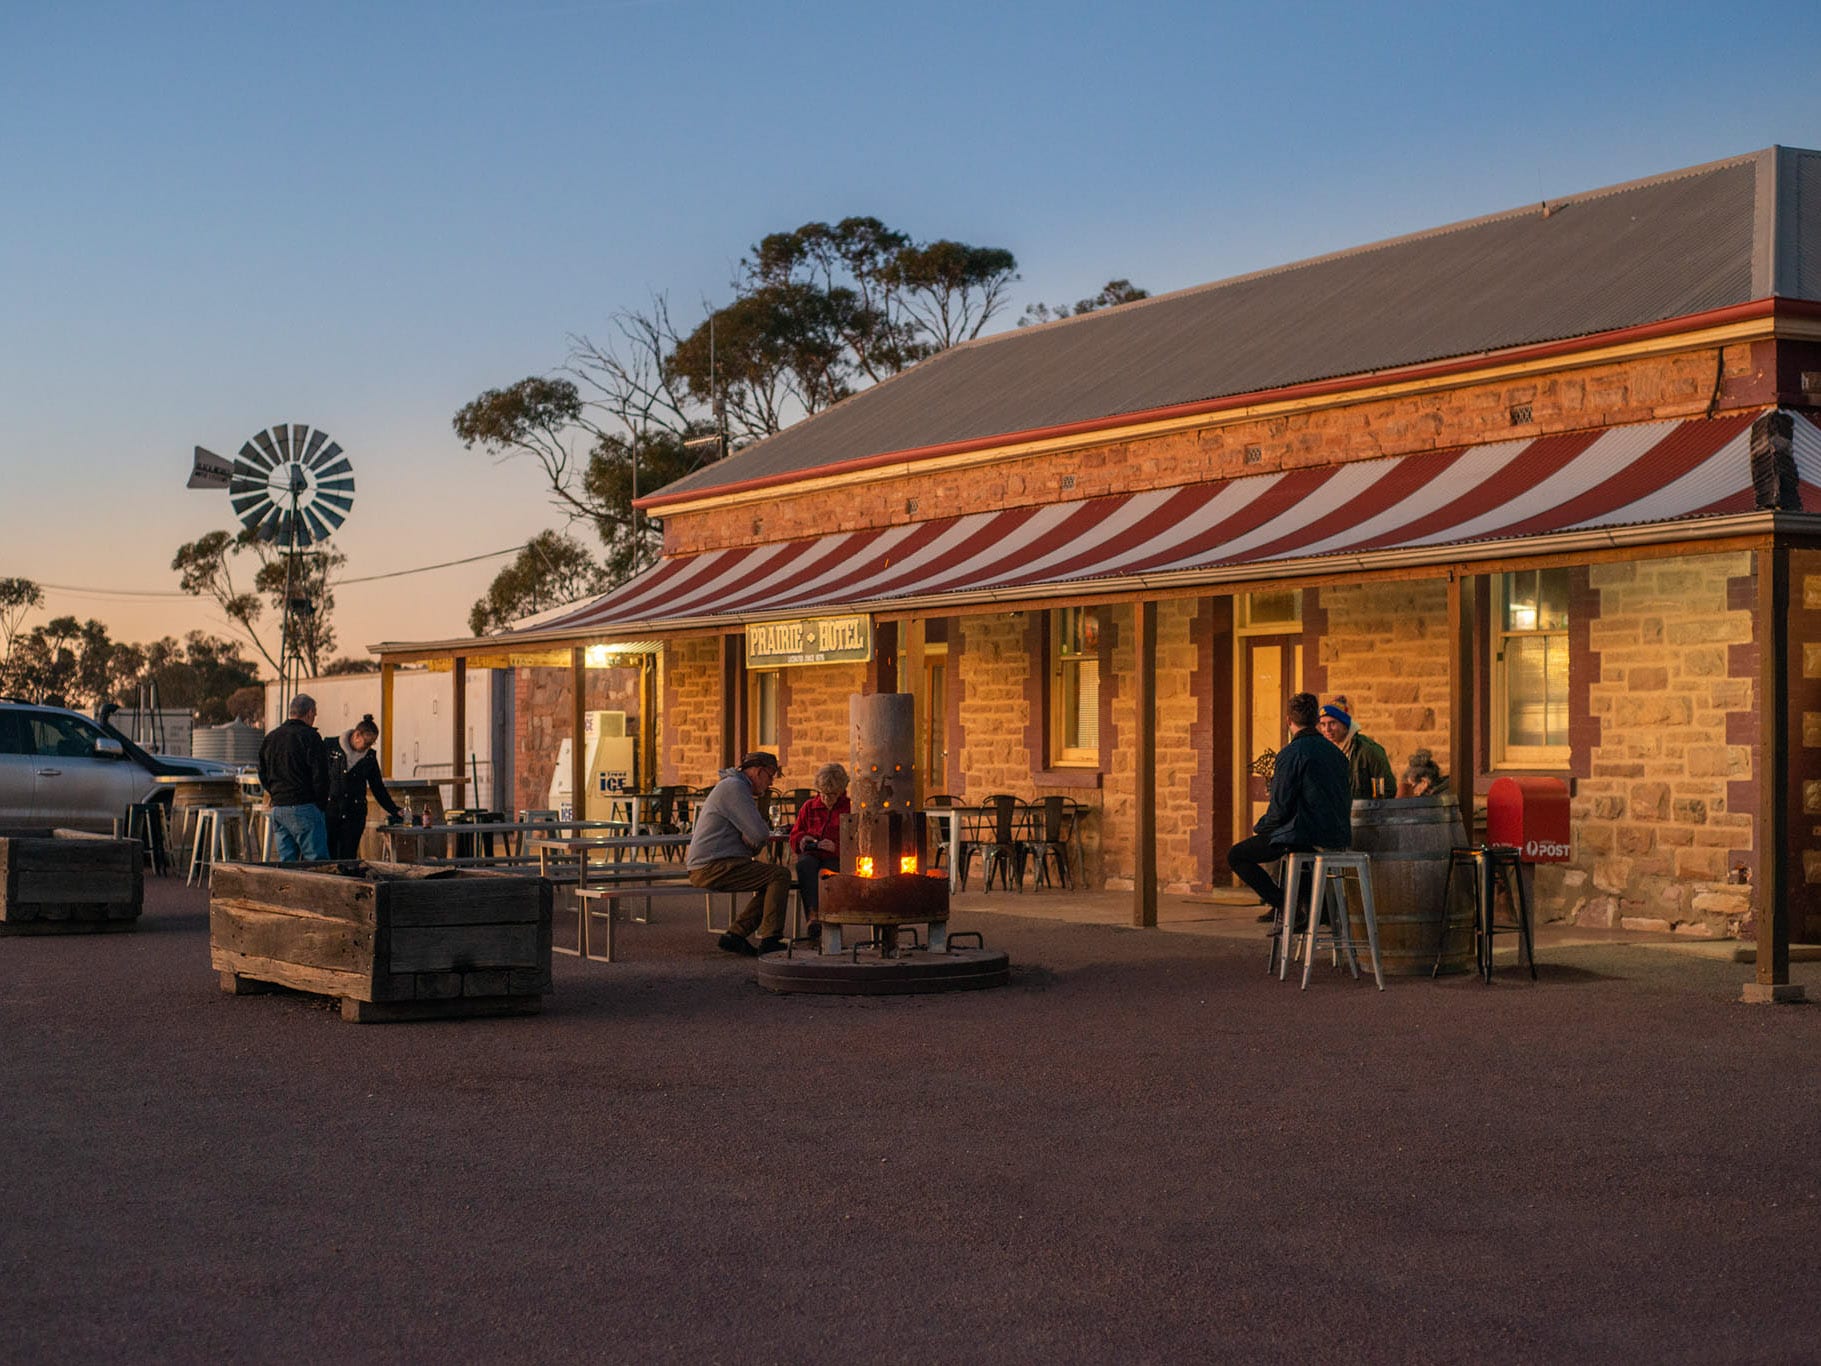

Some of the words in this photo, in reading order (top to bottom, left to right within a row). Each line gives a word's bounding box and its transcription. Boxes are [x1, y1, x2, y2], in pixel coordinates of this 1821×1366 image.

[750, 624, 803, 656] PRAIRIE
[818, 618, 864, 651] HOTEL
[1539, 844, 1570, 857] POST
